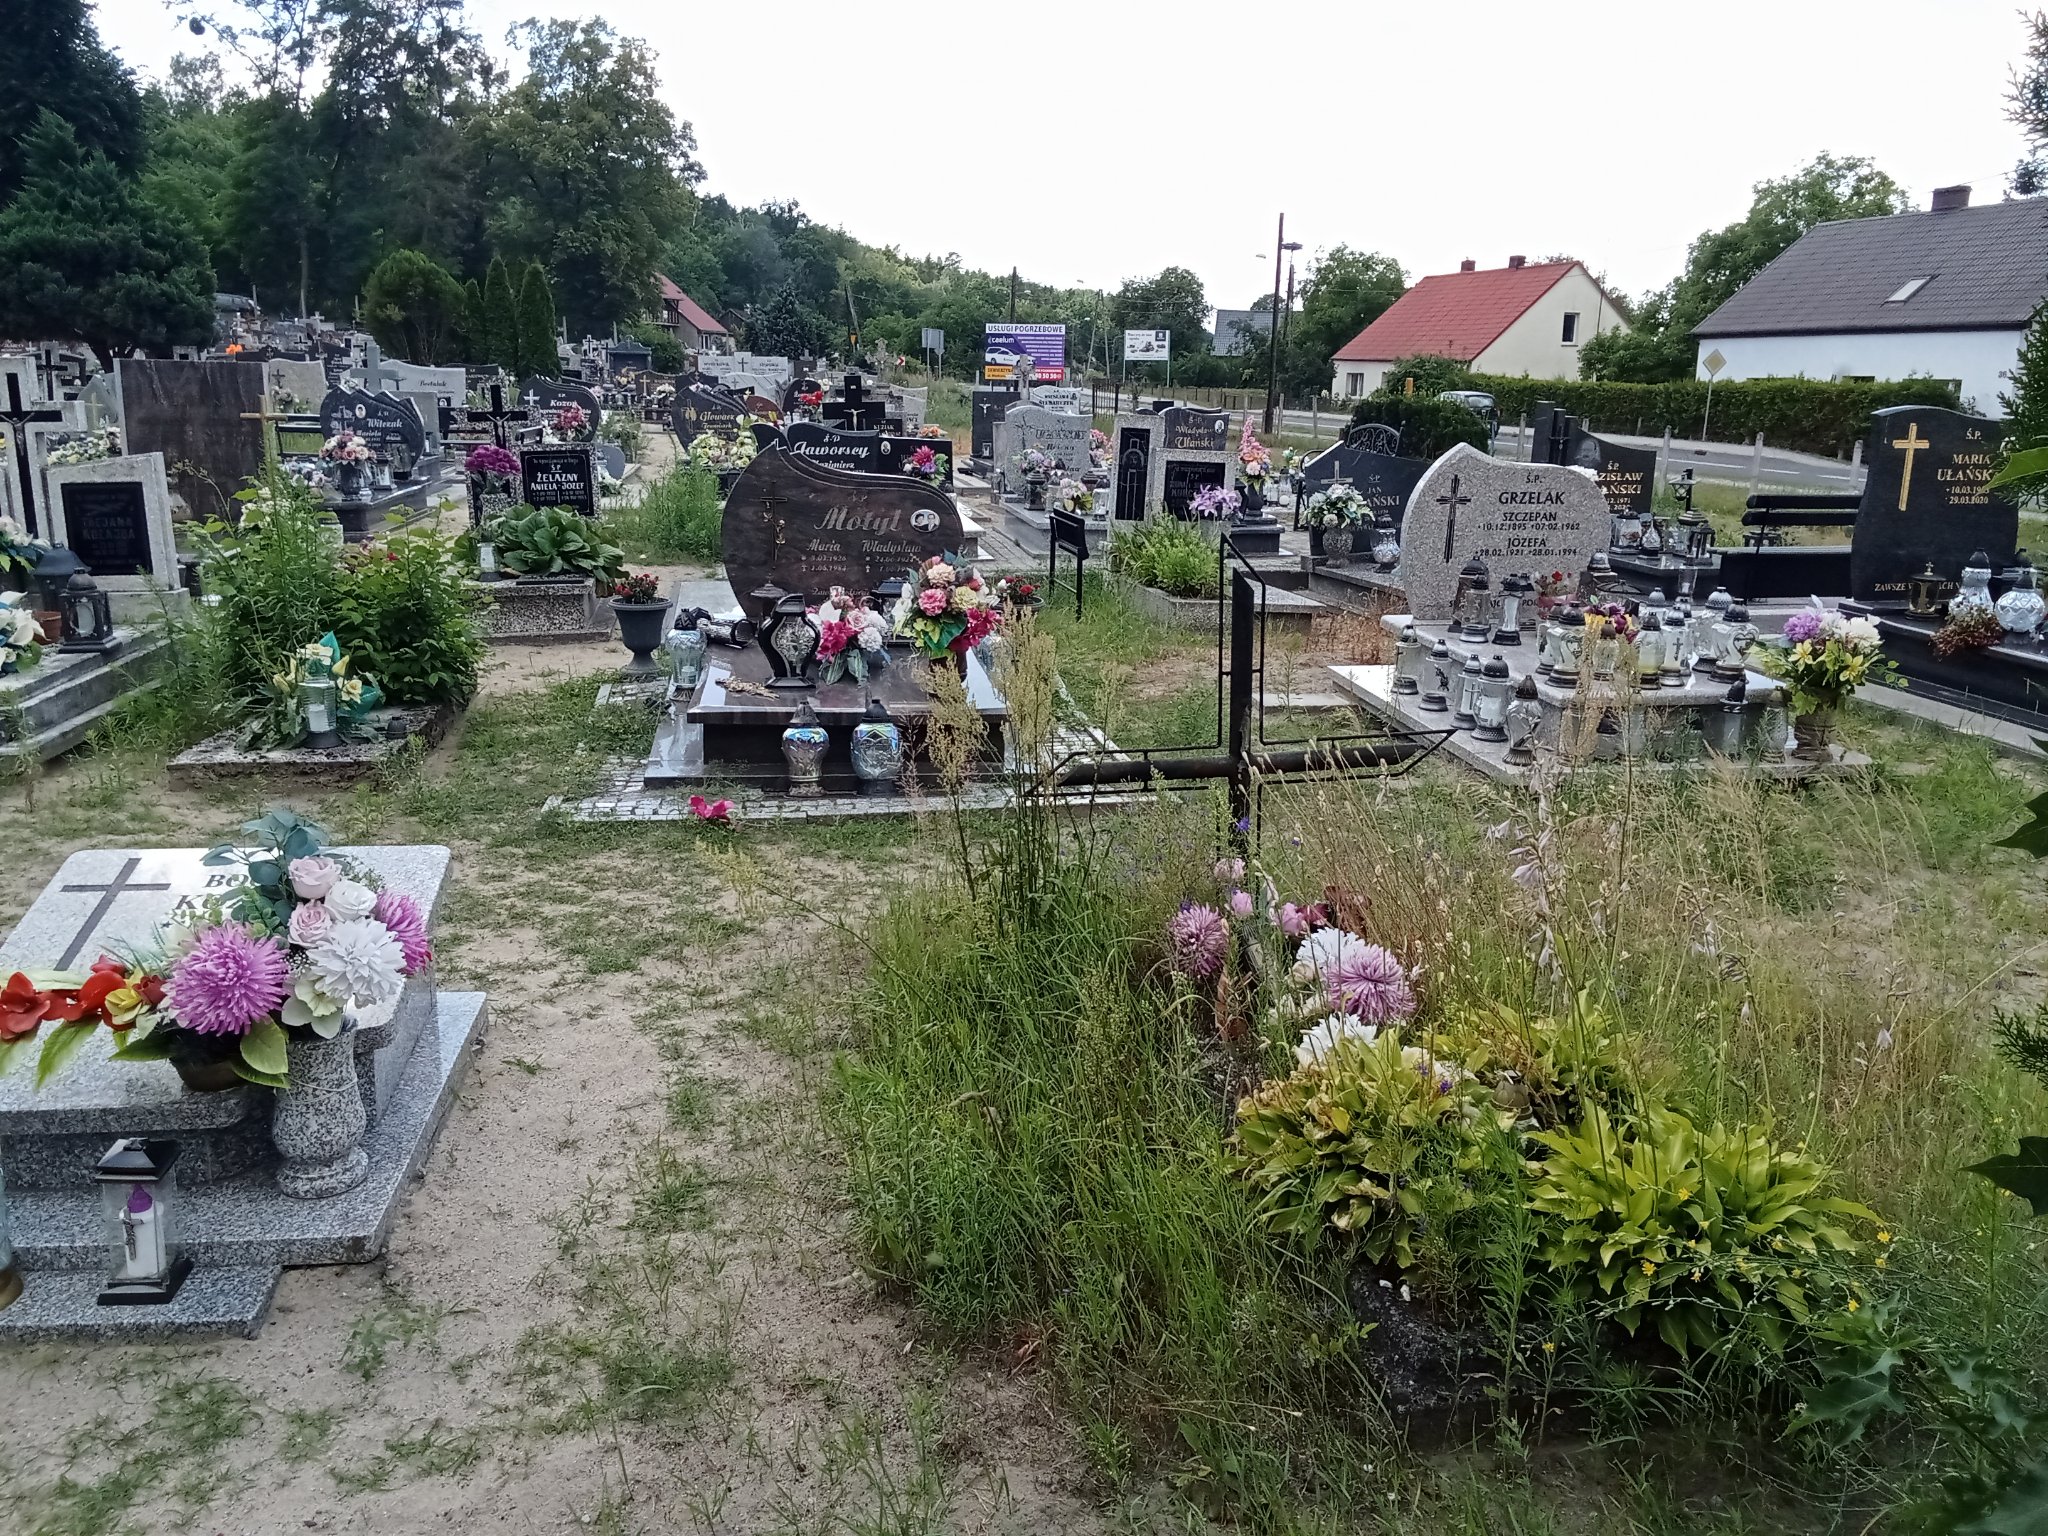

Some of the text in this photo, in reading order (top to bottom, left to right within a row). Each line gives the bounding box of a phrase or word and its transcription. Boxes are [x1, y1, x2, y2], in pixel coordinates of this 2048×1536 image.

[1014, 325, 1063, 333] POGRZEBOWE
[1952, 453, 1991, 465] MARIA
[536, 471, 579, 482] ŻELAZNY
[1937, 465, 1992, 481] UŁAŃSK
[1367, 486, 1382, 494] JAN
[1366, 493, 1400, 507] AŃSKI
[1498, 491, 1566, 505] GRZELAK
[1502, 511, 1558, 522] SZCZEPAN
[806, 538, 841, 552] Maria
[1507, 534, 1547, 548] JÓZEFA
[1874, 582, 1906, 591] ZAWSZE
